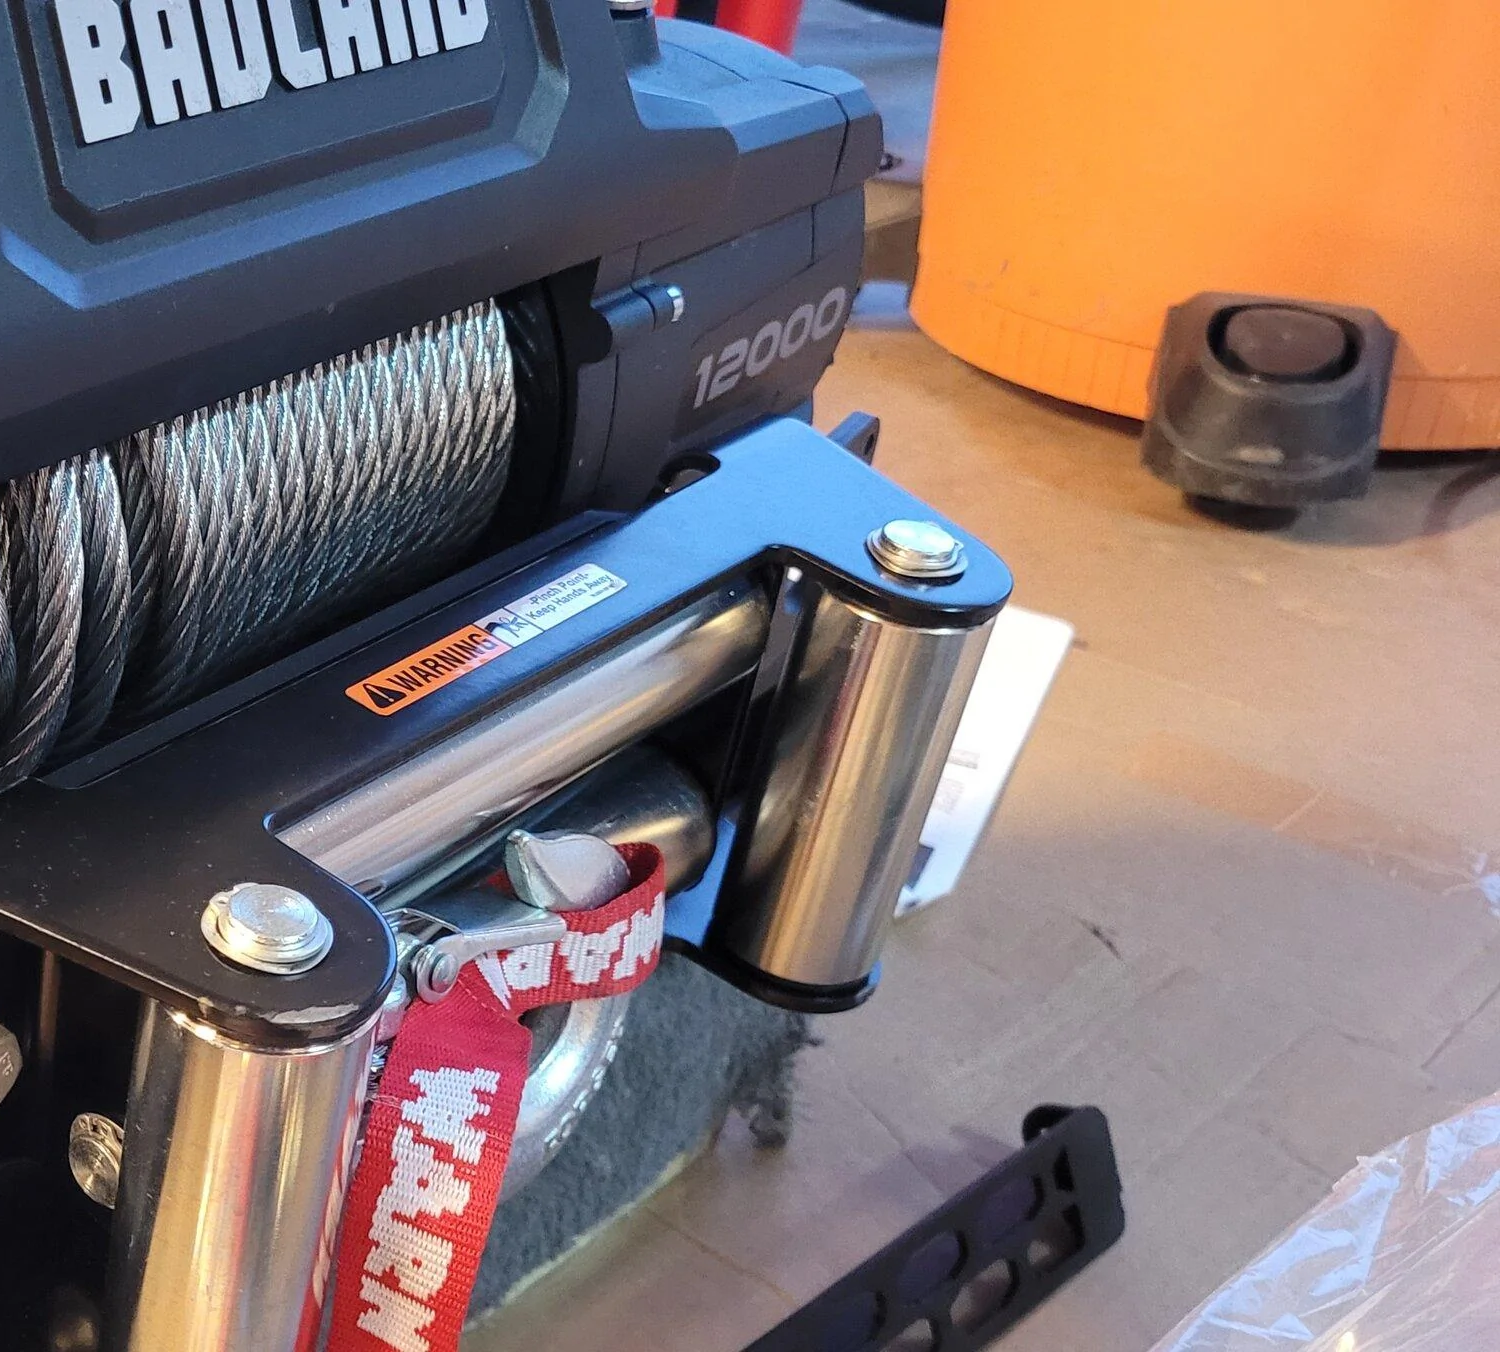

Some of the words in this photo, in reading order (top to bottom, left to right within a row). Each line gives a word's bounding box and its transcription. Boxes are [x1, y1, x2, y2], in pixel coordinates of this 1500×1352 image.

[693, 286, 847, 410] 12000
[526, 603, 557, 621] Keep
[553, 586, 587, 607] Hands
[584, 574, 615, 591] Away
[385, 633, 499, 692] WARNING
[356, 1066, 501, 1352] WARN
